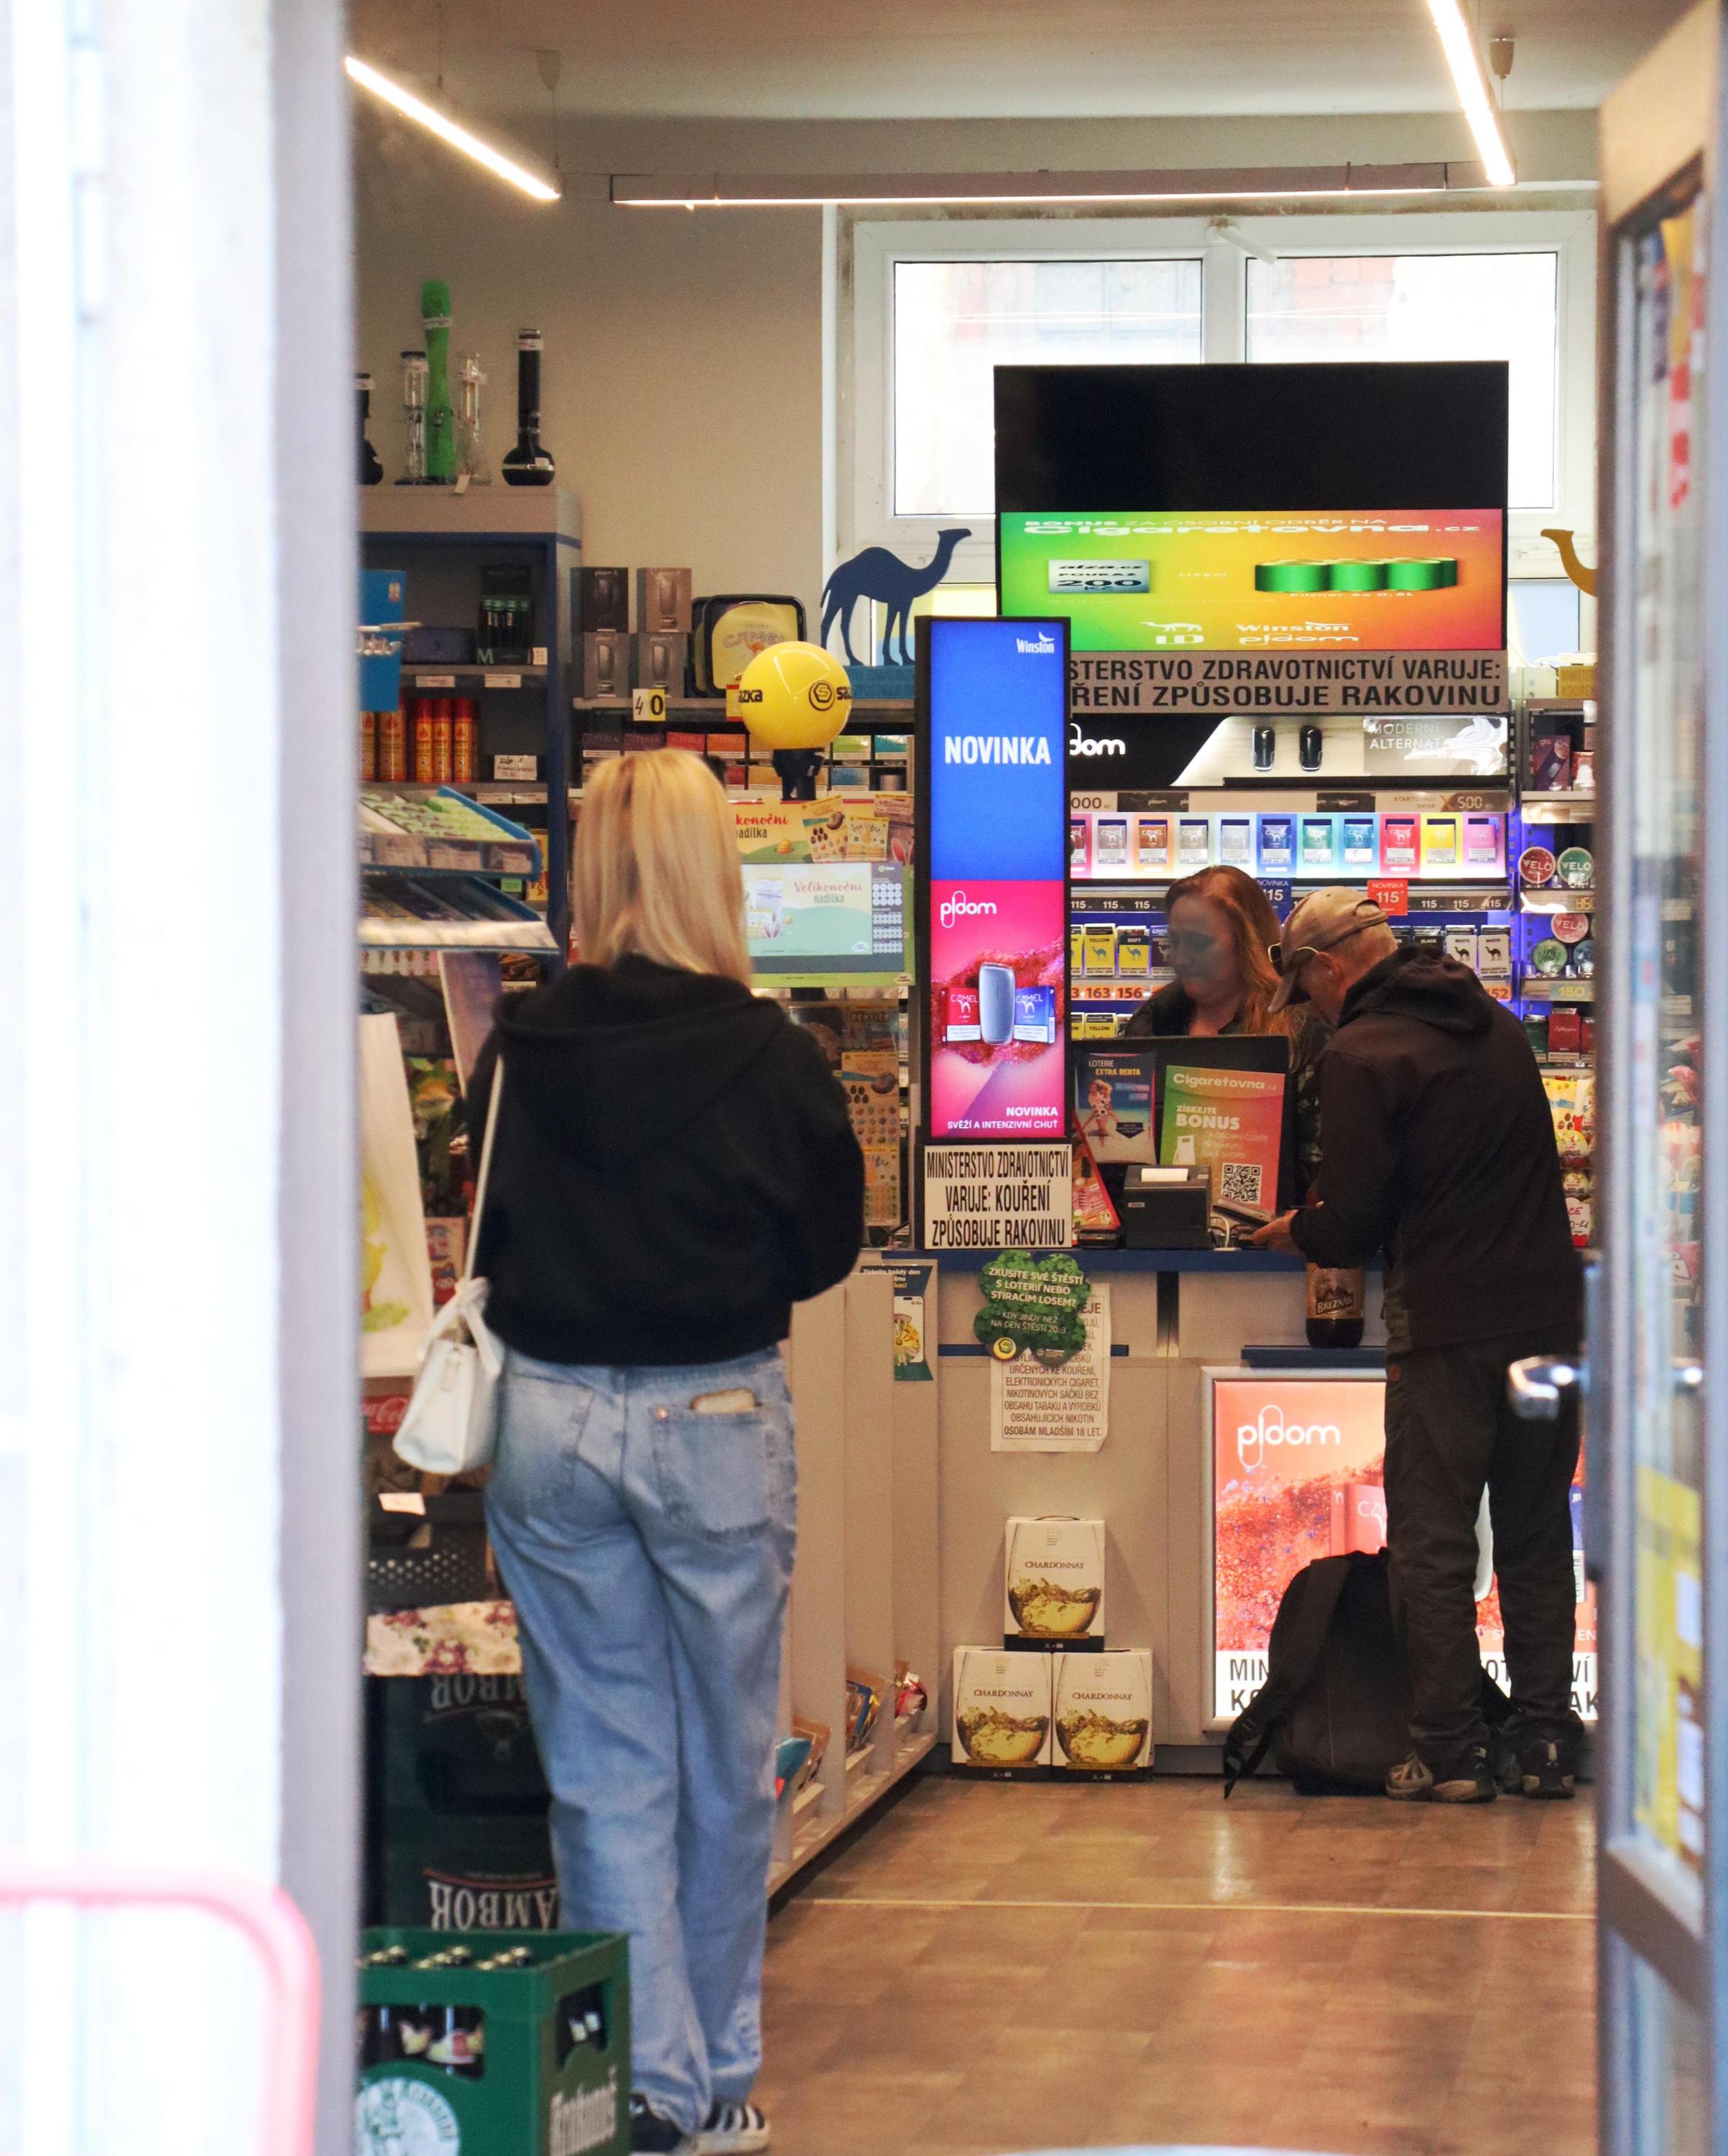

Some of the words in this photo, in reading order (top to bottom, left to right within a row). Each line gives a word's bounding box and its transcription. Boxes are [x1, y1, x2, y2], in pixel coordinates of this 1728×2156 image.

[1235, 623, 1349, 632] Winston
[1239, 632, 1359, 646] ploom
[1016, 638, 1055, 653] Winston
[1070, 660, 1193, 680] STERSTVO
[1203, 655, 1395, 680] ZDRAVOTNICTVÍ
[1403, 659, 1500, 679] VARUJE:
[738, 688, 763, 704] azka
[1071, 682, 1143, 706] ŘENÍ
[1152, 681, 1329, 706] ZPŮSOBUJE
[1341, 686, 1500, 706] RAKOVINU
[1369, 737, 1443, 749] ALTERNAT
[944, 735, 1051, 765] NOVINKA
[1071, 796, 1101, 809] 000
[1457, 796, 1482, 809] 500
[736, 813, 789, 826] konoční
[1523, 859, 1552, 872] VELO
[1561, 861, 1591, 871] VELO
[794, 880, 863, 893] Velikonoční
[814, 893, 845, 903] nadílka
[1377, 891, 1400, 903] 115
[940, 890, 997, 929] ploom
[1070, 900, 1086, 909] 115
[1102, 900, 1119, 909] 115
[1134, 900, 1150, 909] 115
[1420, 900, 1437, 908] 115
[1453, 899, 1469, 908] 115
[1555, 918, 1585, 931] VELO
[950, 993, 979, 1003] CAMEL
[1015, 993, 1044, 1003] CAMEL
[1086, 987, 1111, 998] 163
[1117, 987, 1142, 998] 156
[1491, 988, 1508, 1000] 52
[1558, 986, 1586, 998] 150
[1006, 1107, 1058, 1116] NOVINKA
[1176, 1103, 1217, 1114] ZÍSKEJTE
[947, 1119, 972, 1129] SVĚŽÍ
[981, 1119, 1032, 1129] INTENZIVNÍ
[1175, 1113, 1240, 1130] BONUS
[927, 1151, 994, 1179] MINISTERSTVO
[997, 1146, 1069, 1178] ZDRAVOTNICTVÍ
[946, 1184, 991, 1212] VARUJE:
[995, 1179, 1051, 1212] KOUŘENÍ
[932, 1213, 1000, 1247] ZPŮSOBUJE
[1005, 1218, 1065, 1246] RAKOVINU
[988, 1267, 1028, 1279] ZKUSÍTE
[1030, 1271, 1049, 1281] SVÉ
[1051, 1272, 1084, 1285] ŠTĚSTÍ
[995, 1279, 1002, 1288] S
[1004, 1280, 1042, 1292] LOTERIÍ
[1043, 1284, 1071, 1295] NEBO
[991, 1290, 1037, 1304] STÍRACÍM
[1038, 1296, 1077, 1307] LOSEM?
[1019, 1313, 1041, 1322] JINDY
[1043, 1314, 1058, 1323] NEŽ
[1004, 1321, 1020, 1330] DEN
[1009, 1364, 1049, 1375] URČENÝCH
[1005, 1376, 1068, 1387] ELEKTRONICKÝCH
[1068, 1377, 1100, 1388] CIGARET,
[1006, 1388, 1058, 1399] NIKOTINOVÝCH
[1085, 1390, 1099, 1399] BEZ
[1004, 1401, 1033, 1410] OBSAHU
[1062, 1402, 1068, 1411] A
[1069, 1400, 1101, 1411] VÝROBKŮ
[1010, 1411, 1063, 1423] OBSAHUJÍCÍCH
[1065, 1414, 1095, 1423] NIKOTIN
[1004, 1424, 1036, 1435] OSOBÁM
[1038, 1425, 1074, 1436] MLADŠÍM
[1076, 1427, 1086, 1437] 18
[1086, 1427, 1101, 1437] LET.
[1237, 1404, 1341, 1468] ploom
[1024, 1561, 1085, 1570] CHARDONNAY
[973, 1689, 1033, 1698] CHARDONNAY
[1071, 1692, 1132, 1701] CHARDONNAY
[428, 1879, 558, 1931] AMBOR
